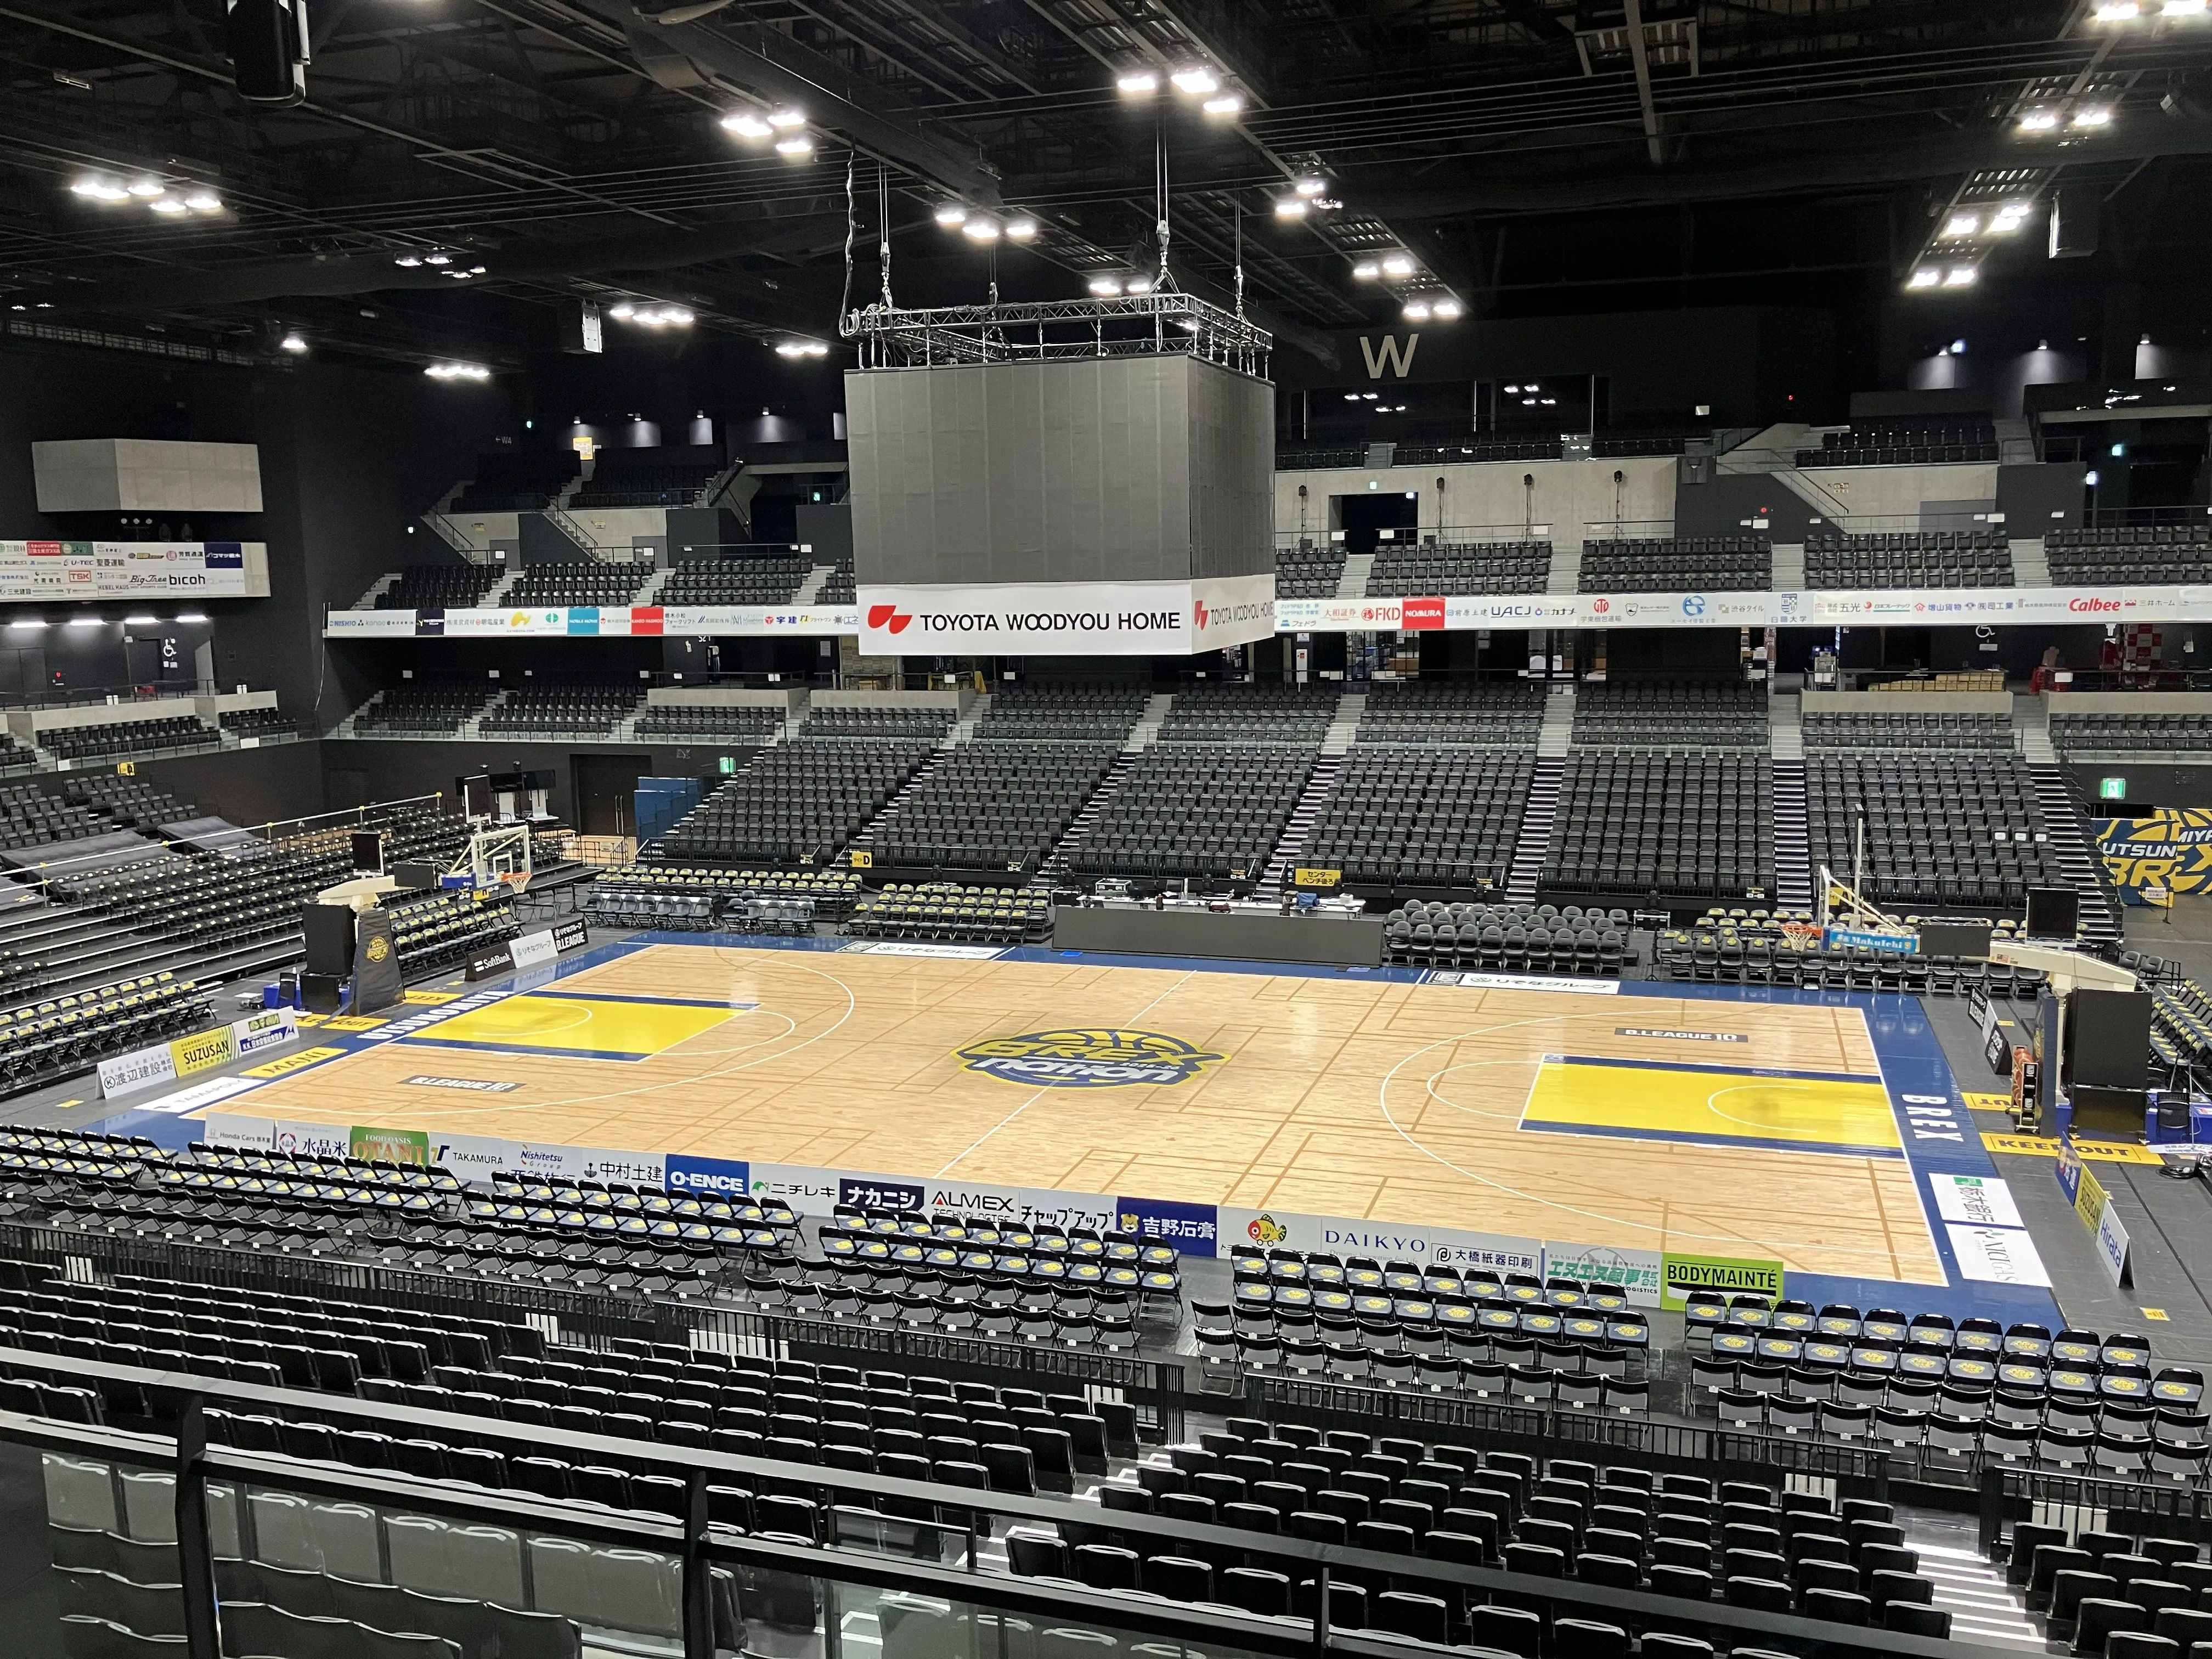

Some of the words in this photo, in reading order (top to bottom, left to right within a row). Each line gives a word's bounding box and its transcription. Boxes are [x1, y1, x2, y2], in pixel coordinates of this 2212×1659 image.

[1359, 334, 1419, 379] W
[168, 574, 206, 585] bicoh
[1324, 608, 1356, 618] 大和証券
[1375, 607, 1401, 621] FKD
[1405, 610, 1442, 618] NOMURA
[1491, 606, 1531, 617] UACJ
[1839, 603, 1861, 613] 五光
[2069, 598, 2121, 612] Calbee
[919, 614, 999, 631] TOYOTA
[1006, 613, 1110, 631] WOODYOU
[1118, 612, 1181, 630] HOME
[1210, 607, 1233, 626] TOYOTA
[483, 952, 512, 970] SoftBank
[357, 990, 515, 1040] UTSUNOMIYA
[1625, 1029, 1713, 1040] B.LEAGUE
[183, 1040, 229, 1064] SUZUSAN
[963, 1040, 1220, 1066] BREX
[262, 1050, 329, 1075] MANI
[973, 1057, 1180, 1082] nation
[115, 1062, 162, 1086] 渡辺建設
[1901, 1093, 1964, 1143] BREX
[219, 1132, 240, 1140] Honda
[388, 1136, 411, 1144] OASIS
[302, 1138, 347, 1156] 水晶米
[353, 1141, 424, 1166] OTANI
[521, 1150, 563, 1163] Nishitetsu
[2074, 1146, 2129, 1156] OUT
[453, 1152, 503, 1165] TAKAMURA
[529, 1161, 561, 1170] Group
[600, 1161, 663, 1183] 中村土建
[771, 1182, 836, 1198] ニチレキ
[847, 1186, 917, 1209] ナカニシ
[931, 1190, 1015, 1213] ALMEX
[1021, 1205, 1114, 1230] チャップアップ
[1142, 1216, 1217, 1240] 吉野石膏
[1324, 1229, 1426, 1252] DAIKYO
[2100, 1218, 2121, 1268] Hirata
[1455, 1249, 1532, 1269] 大橋紙器印刷
[1667, 1263, 1777, 1288] BODYMAINTÉ
